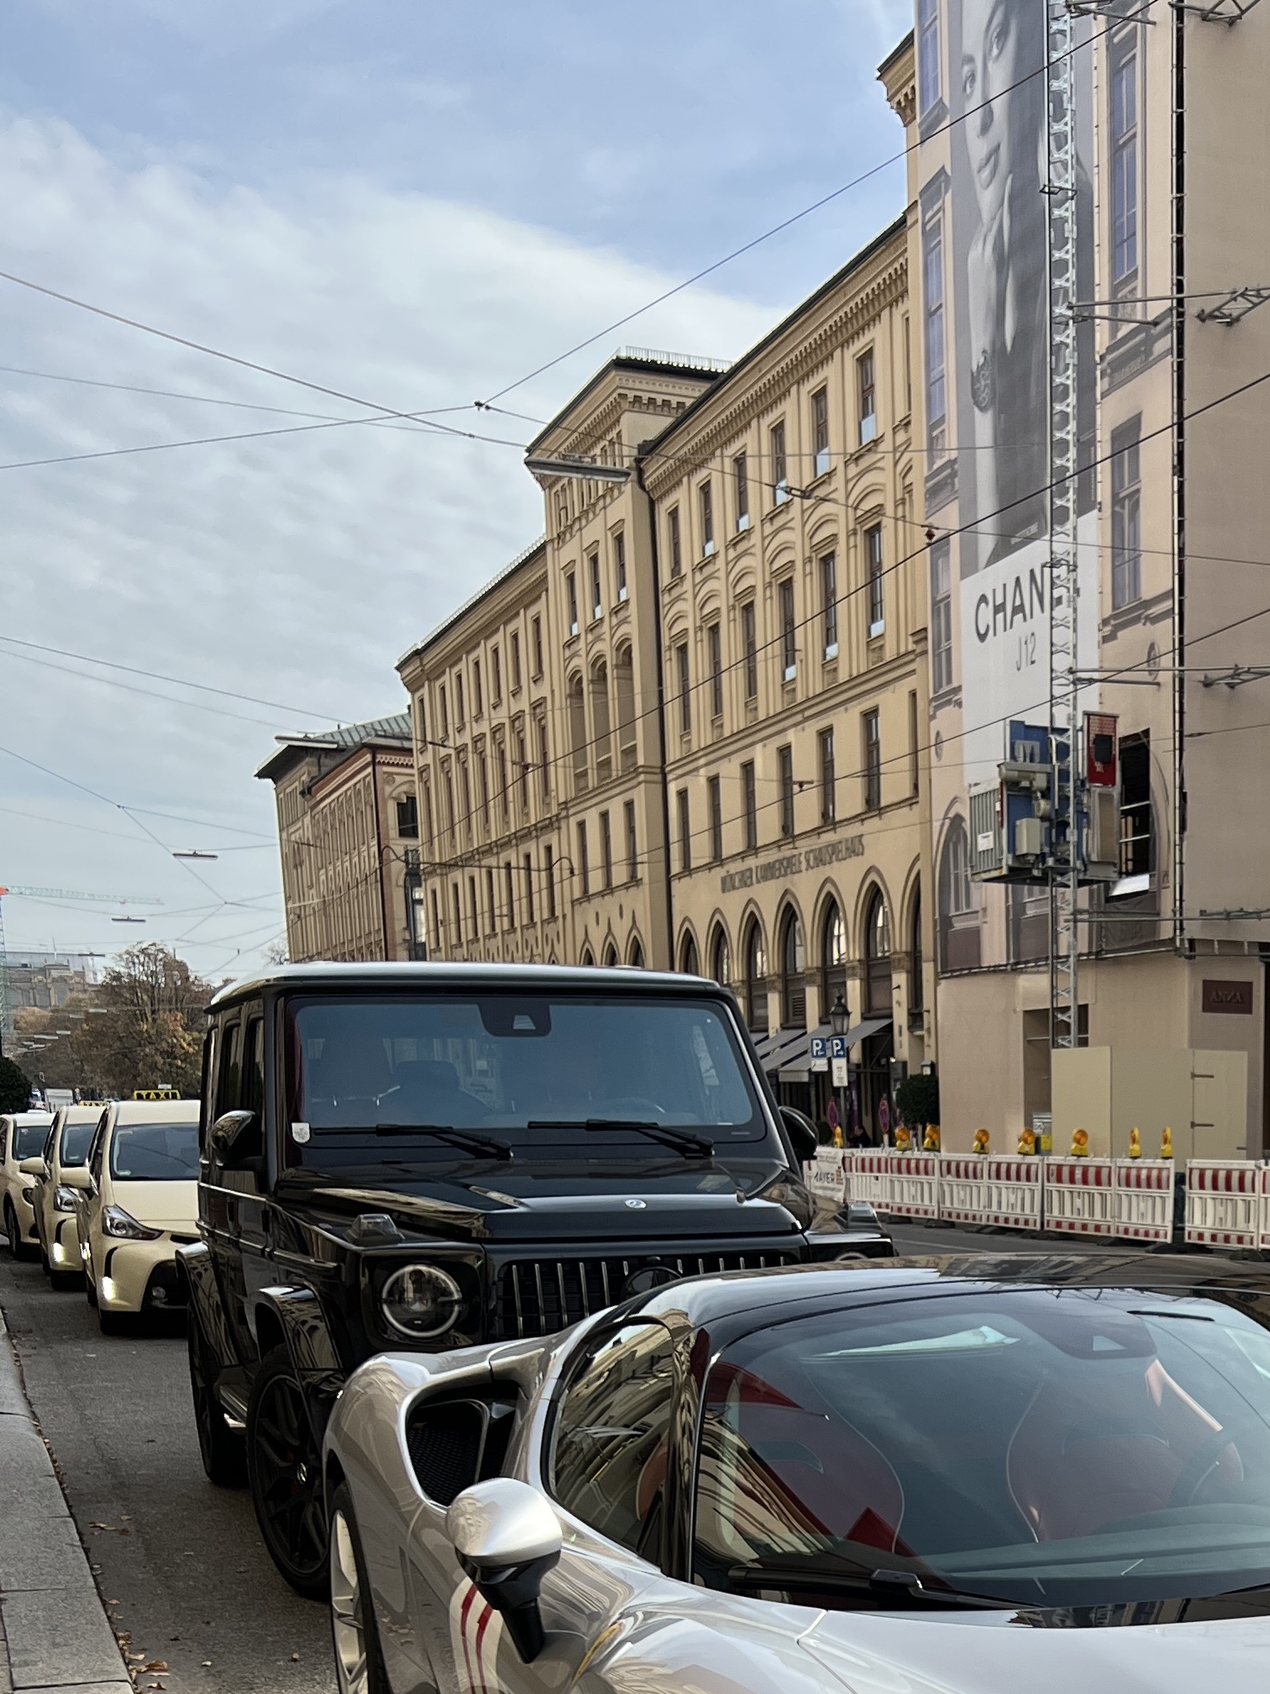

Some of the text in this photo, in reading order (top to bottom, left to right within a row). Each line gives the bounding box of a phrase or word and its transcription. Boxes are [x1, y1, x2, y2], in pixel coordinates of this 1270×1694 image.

[975, 563, 1080, 643] CHAN
[1016, 632, 1036, 671] J12
[142, 1091, 172, 1100] TAXI
